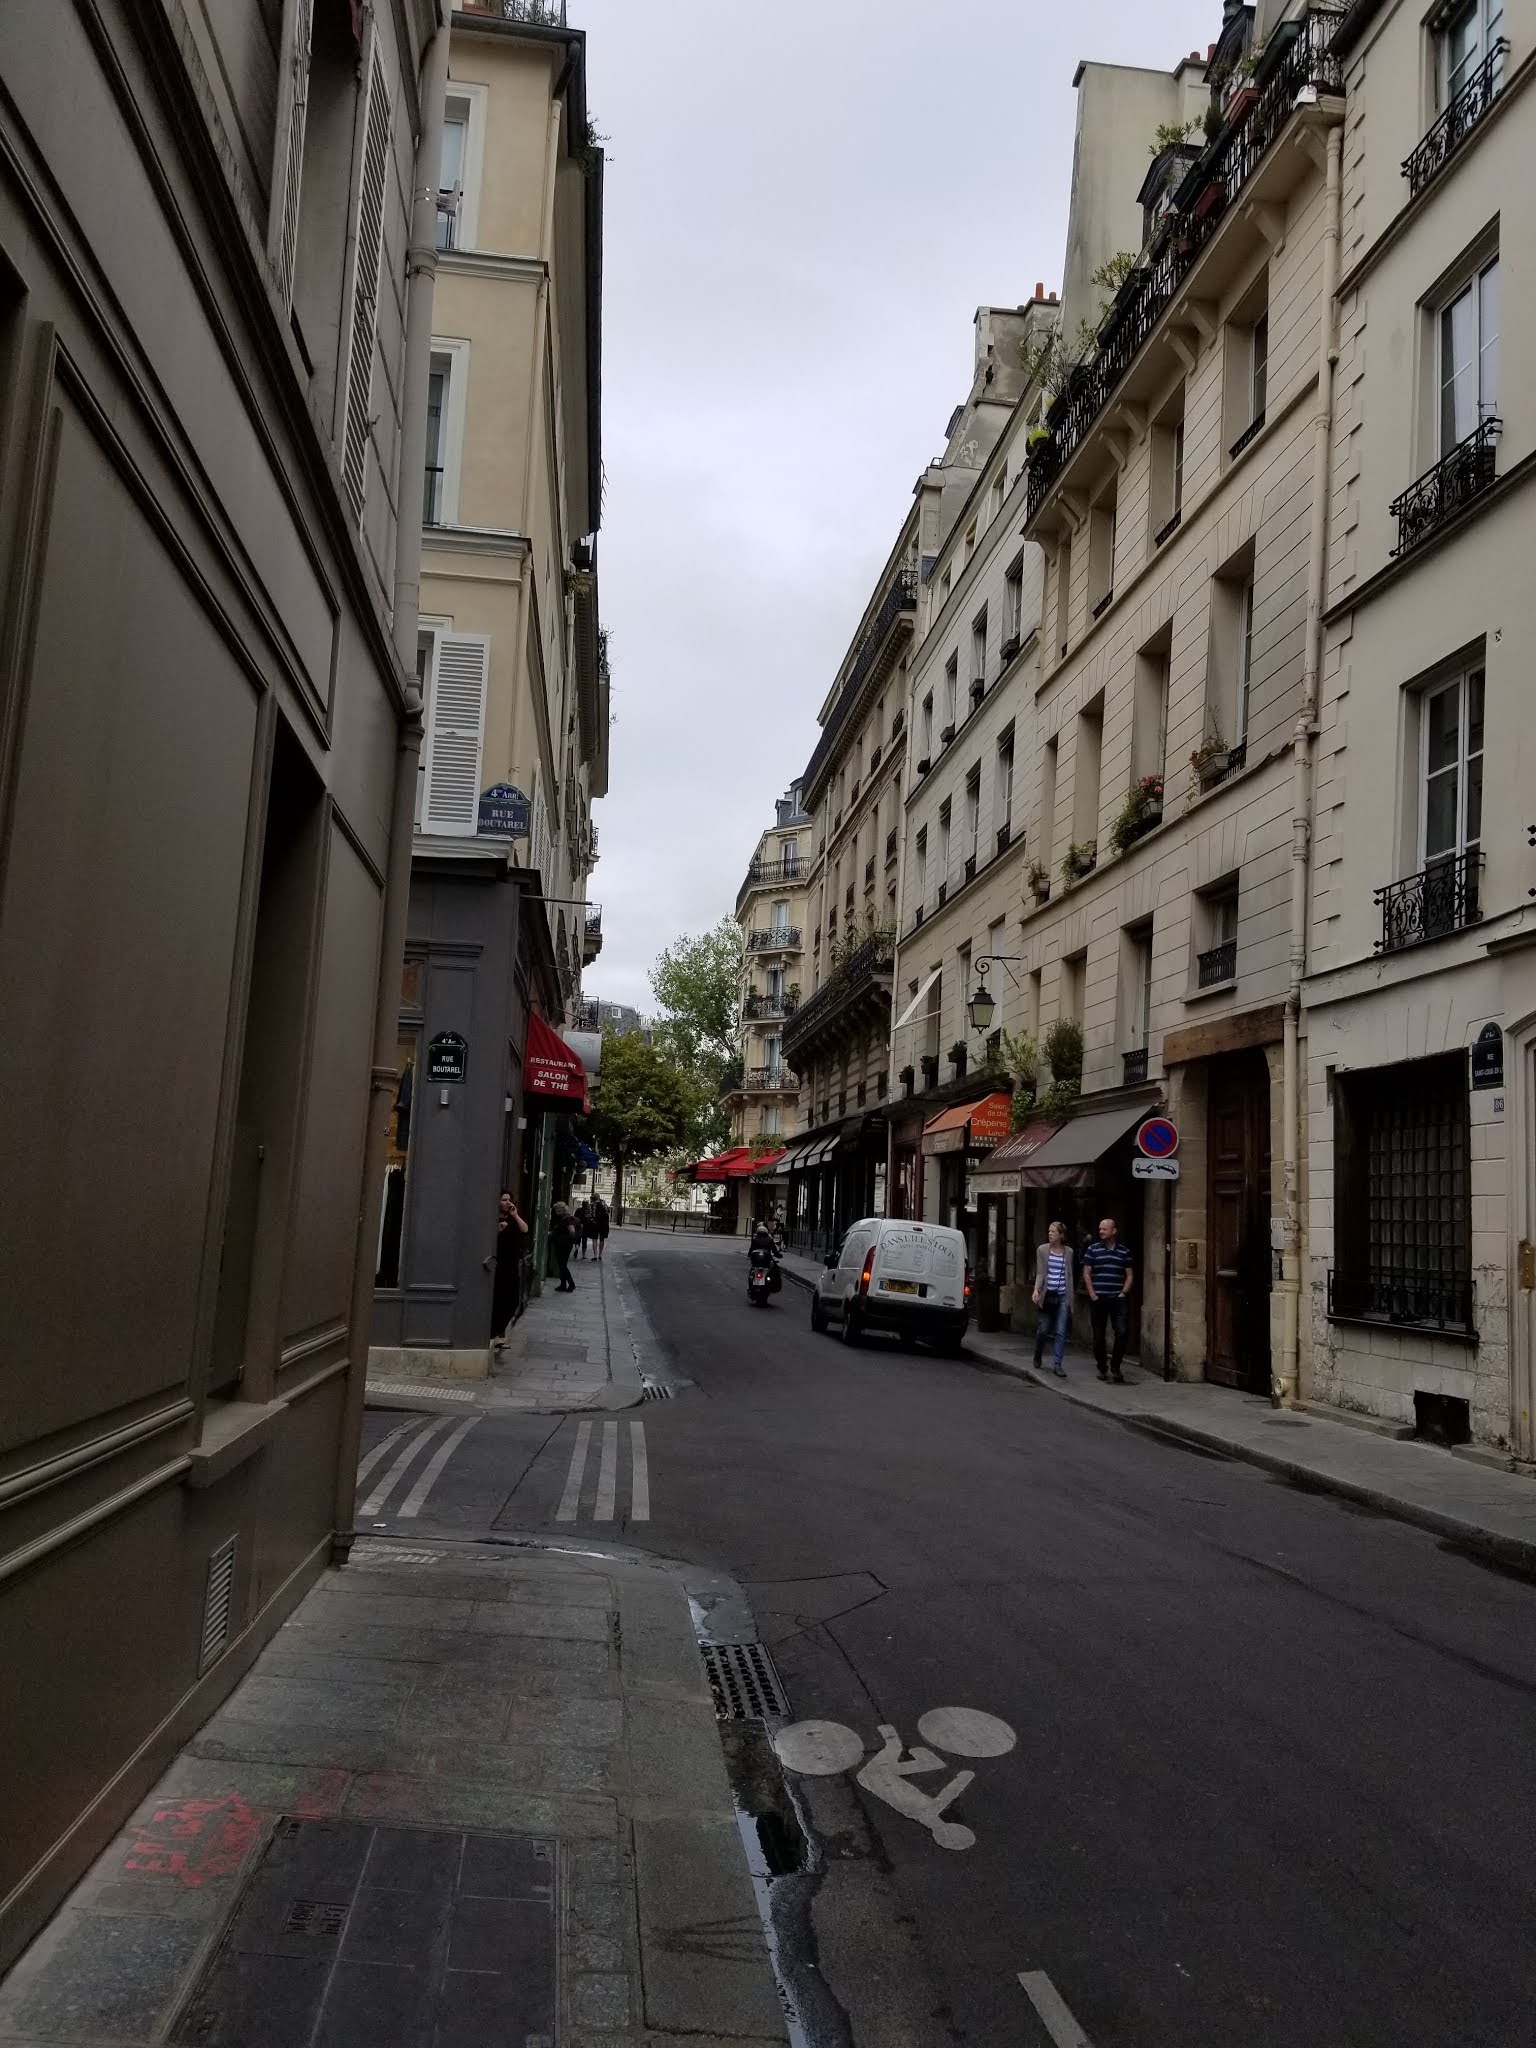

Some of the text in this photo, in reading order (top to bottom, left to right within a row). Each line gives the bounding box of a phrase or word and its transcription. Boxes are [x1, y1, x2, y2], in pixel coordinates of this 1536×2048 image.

[492, 809, 514, 819] RUE
[441, 1055, 454, 1063] RUE
[530, 1056, 577, 1069] RESTAURANT
[432, 1065, 461, 1074] BOUTAREL
[537, 1070, 569, 1081] SALON
[533, 1079, 546, 1087] DE
[988, 1101, 1007, 1110] Salon
[987, 1109, 996, 1117] de
